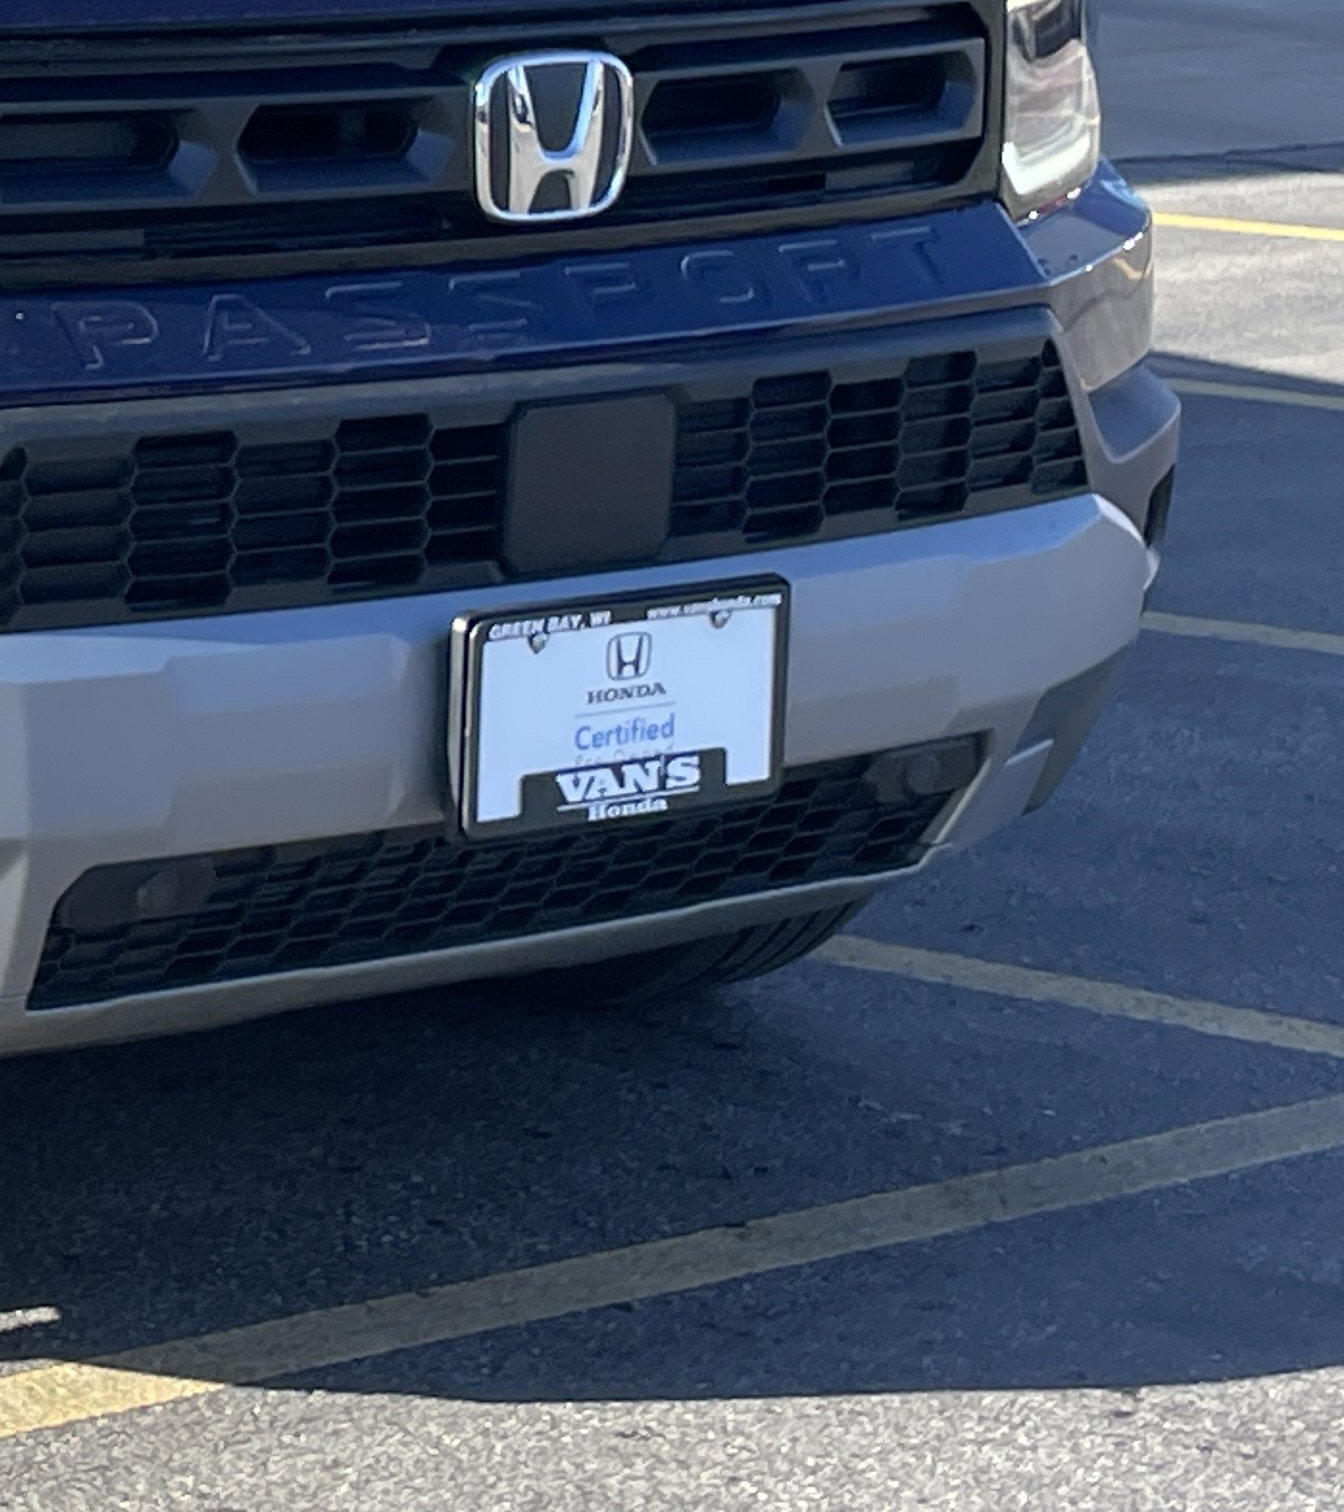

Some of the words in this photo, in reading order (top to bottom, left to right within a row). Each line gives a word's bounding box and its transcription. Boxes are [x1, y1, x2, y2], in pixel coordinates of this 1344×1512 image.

[52, 226, 945, 370] PASSPORT
[489, 618, 546, 641] GREEN
[585, 681, 667, 706] HONDA
[574, 712, 676, 751] Certified
[587, 799, 669, 822] Honda
